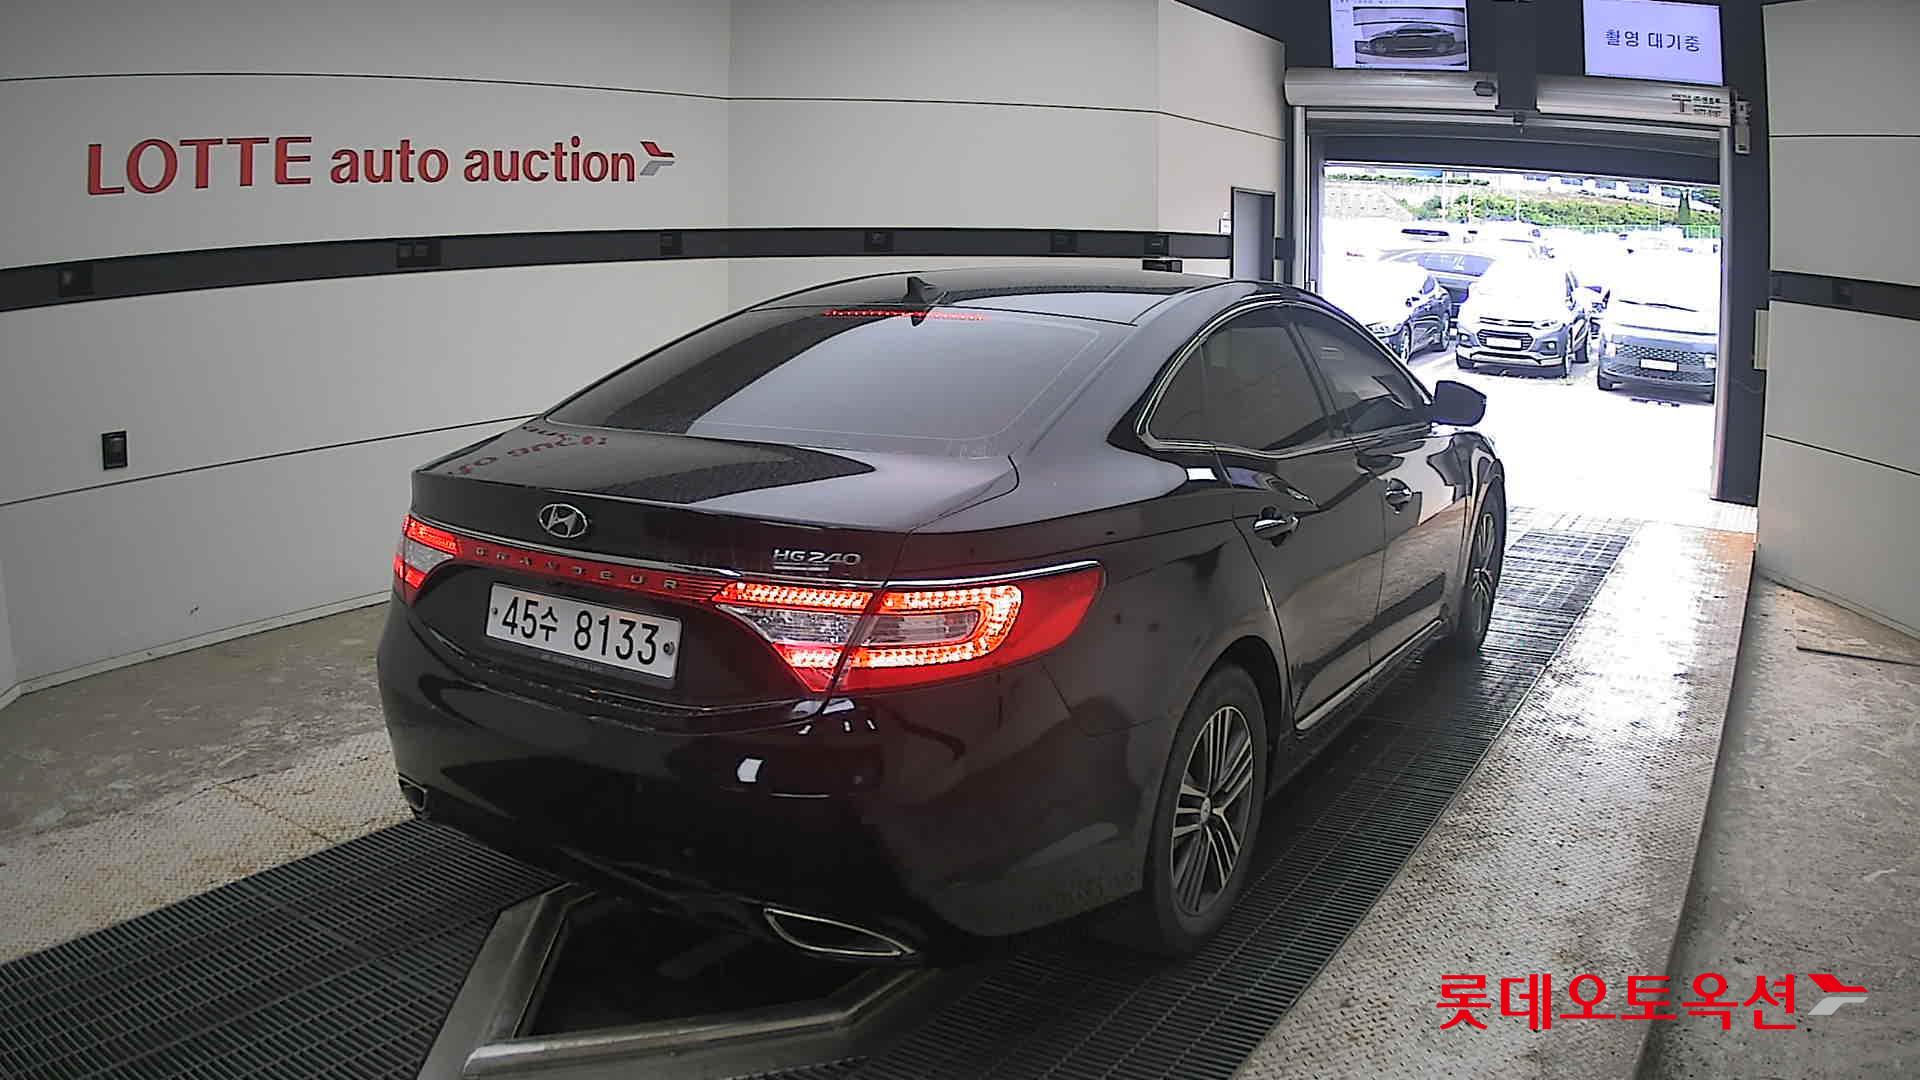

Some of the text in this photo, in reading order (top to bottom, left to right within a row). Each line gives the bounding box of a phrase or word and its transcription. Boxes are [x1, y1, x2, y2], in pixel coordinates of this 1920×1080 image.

[1648, 31, 1700, 52] 대기중
[87, 135, 637, 196] LOTTE auto auction
[502, 597, 559, 642] 45수
[573, 610, 660, 666] 8133
